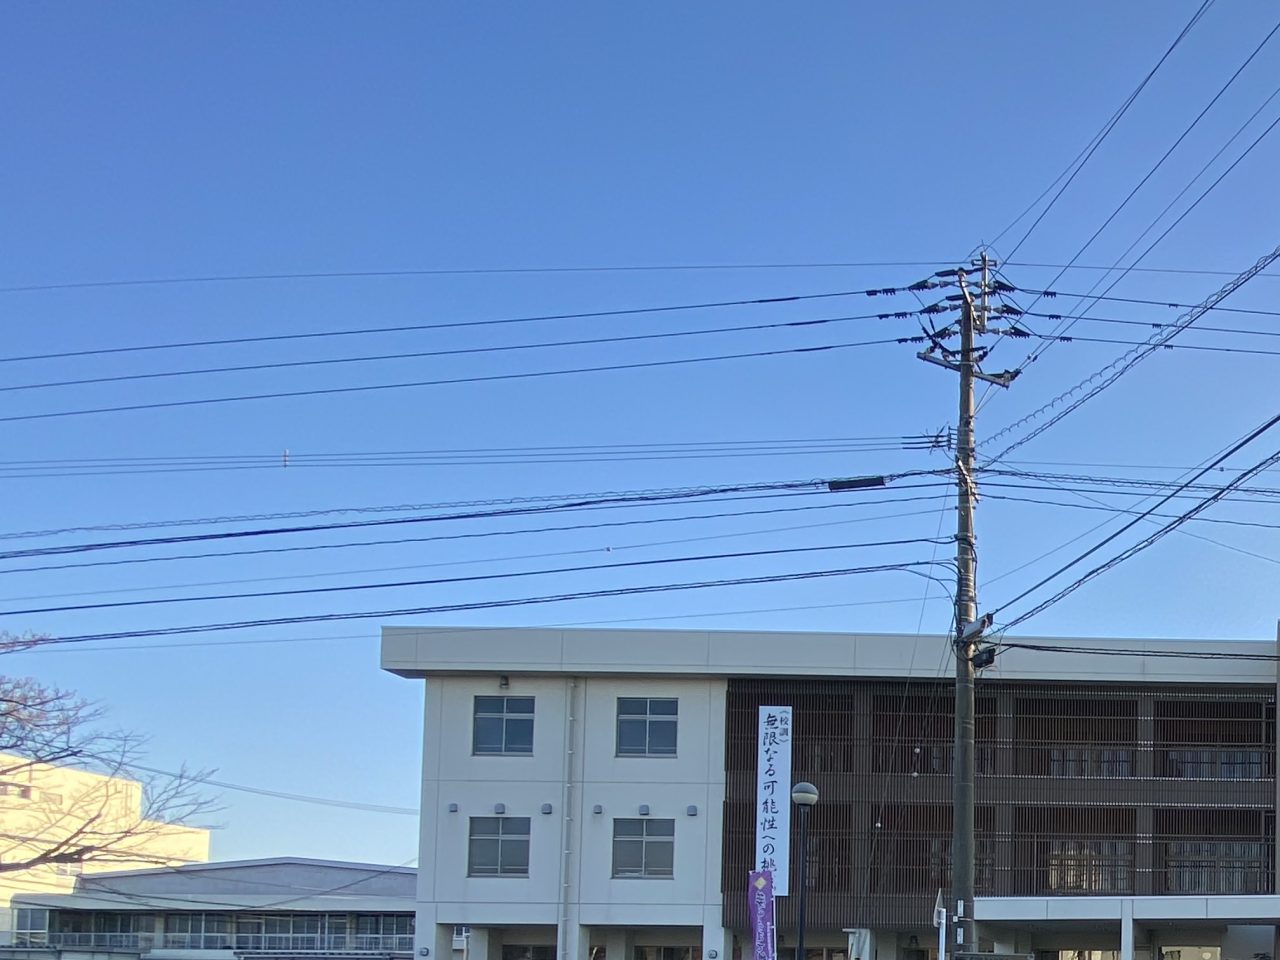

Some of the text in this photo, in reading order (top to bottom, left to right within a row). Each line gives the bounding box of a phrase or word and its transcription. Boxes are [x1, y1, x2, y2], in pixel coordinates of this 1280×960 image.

[760, 713, 780, 892] 無限なる可能性への挑
